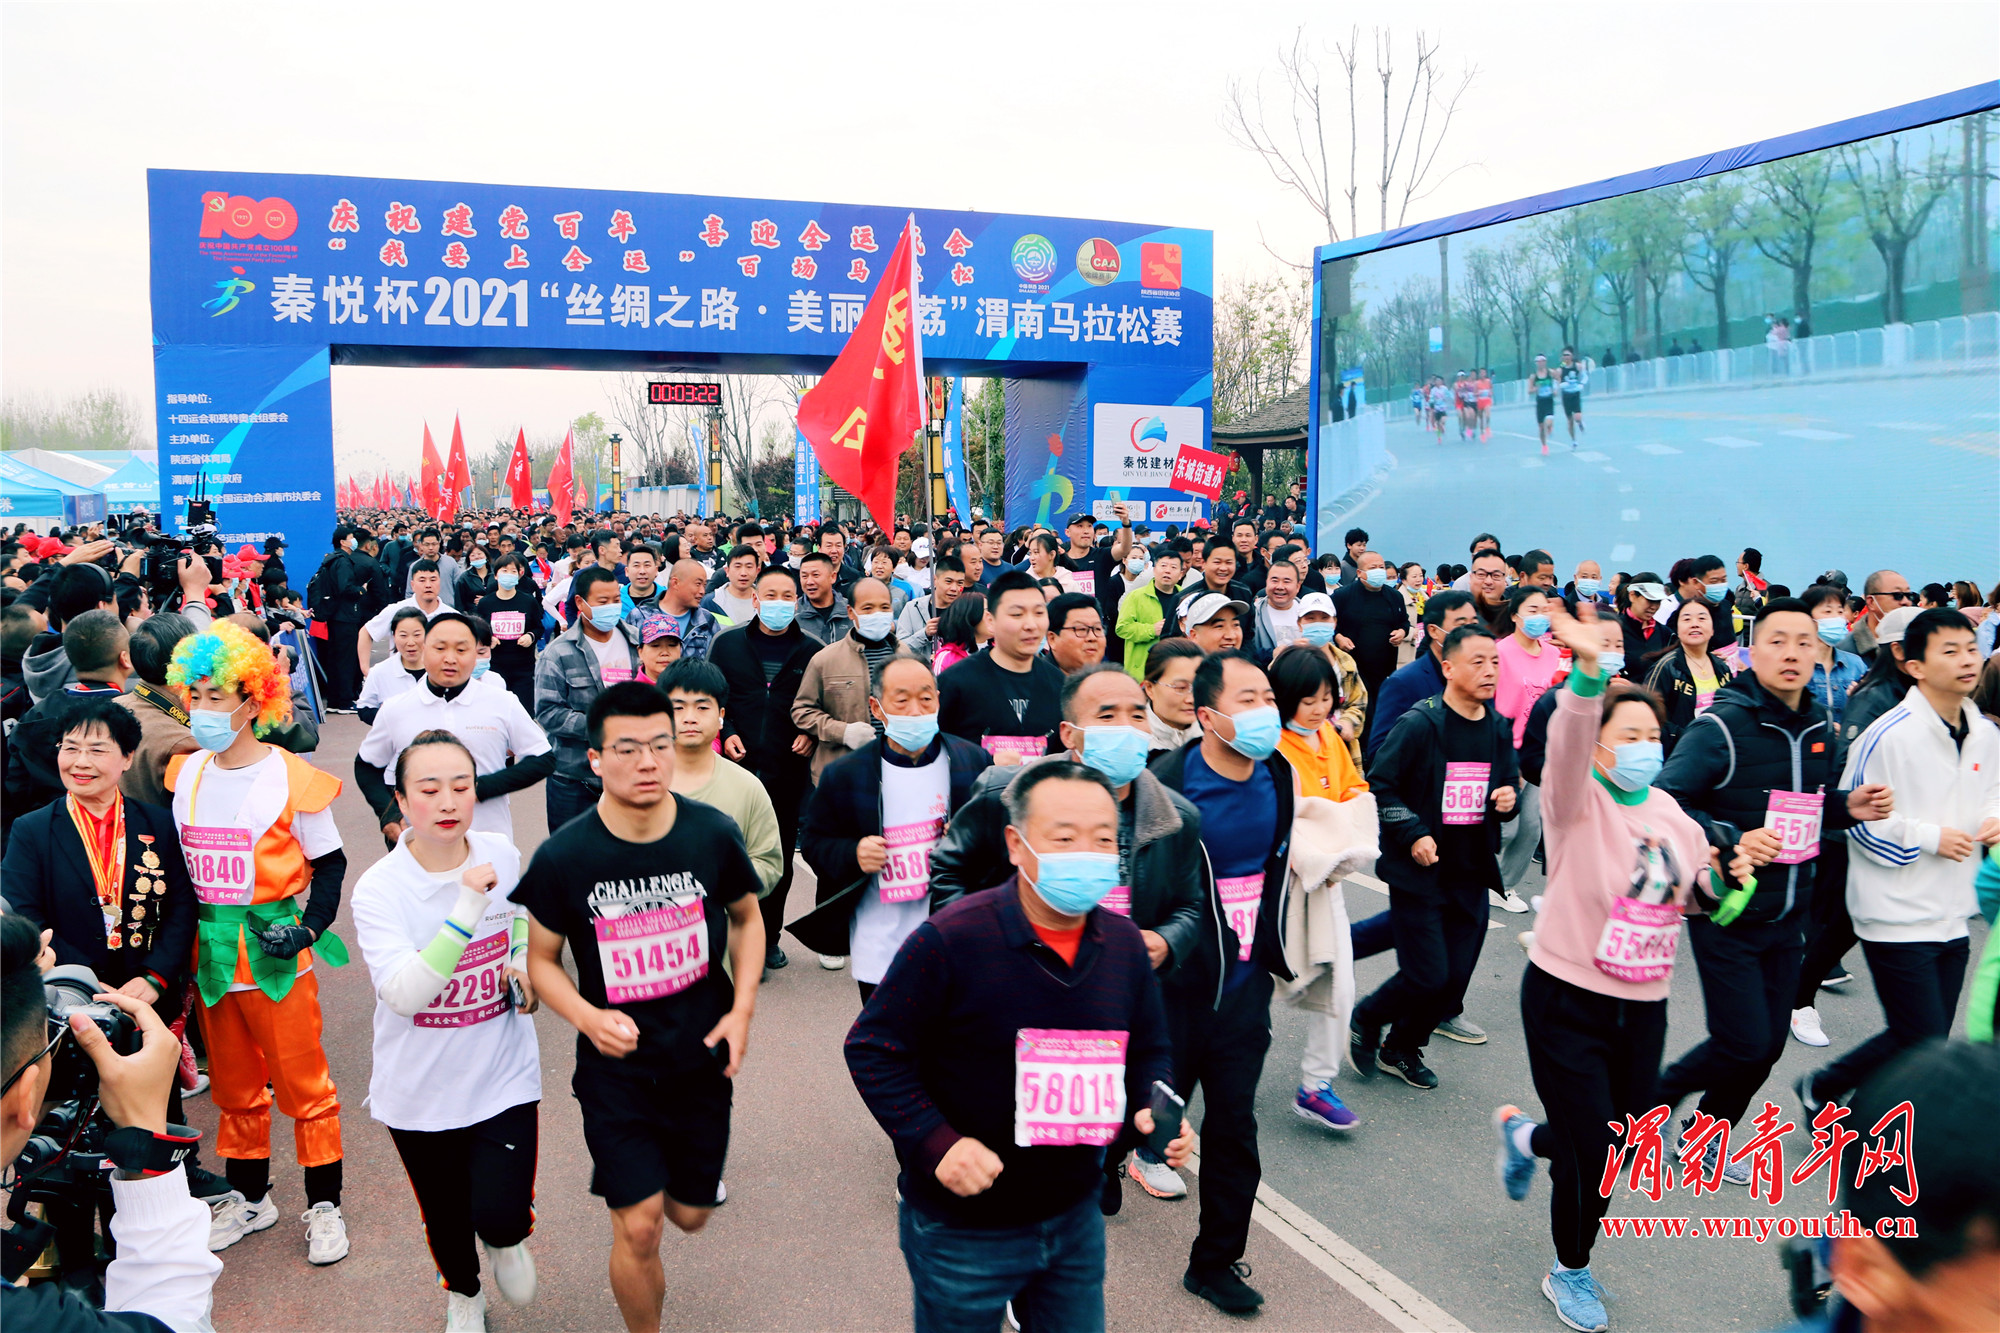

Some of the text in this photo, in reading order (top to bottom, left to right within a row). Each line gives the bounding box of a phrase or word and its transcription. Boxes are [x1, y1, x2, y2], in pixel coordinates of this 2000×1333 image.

[328, 198, 638, 243] 庆祝建党百年
[737, 252, 975, 287] 百场马松
[1093, 257, 1118, 268] CAA
[651, 384, 719, 403] 00:03:22
[171, 453, 232, 465] 陕西省体育局
[1123, 455, 1174, 470] 秦悦建材
[1175, 455, 1223, 489] 东城街道办
[173, 490, 322, 506] 第十届全国运动会渭南市执委会
[494, 621, 522, 633] 52719
[184, 851, 246, 885] 51840
[594, 871, 693, 903] CHALLENGE
[611, 933, 701, 978] 51454
[1023, 1072, 1117, 1116] 58014
